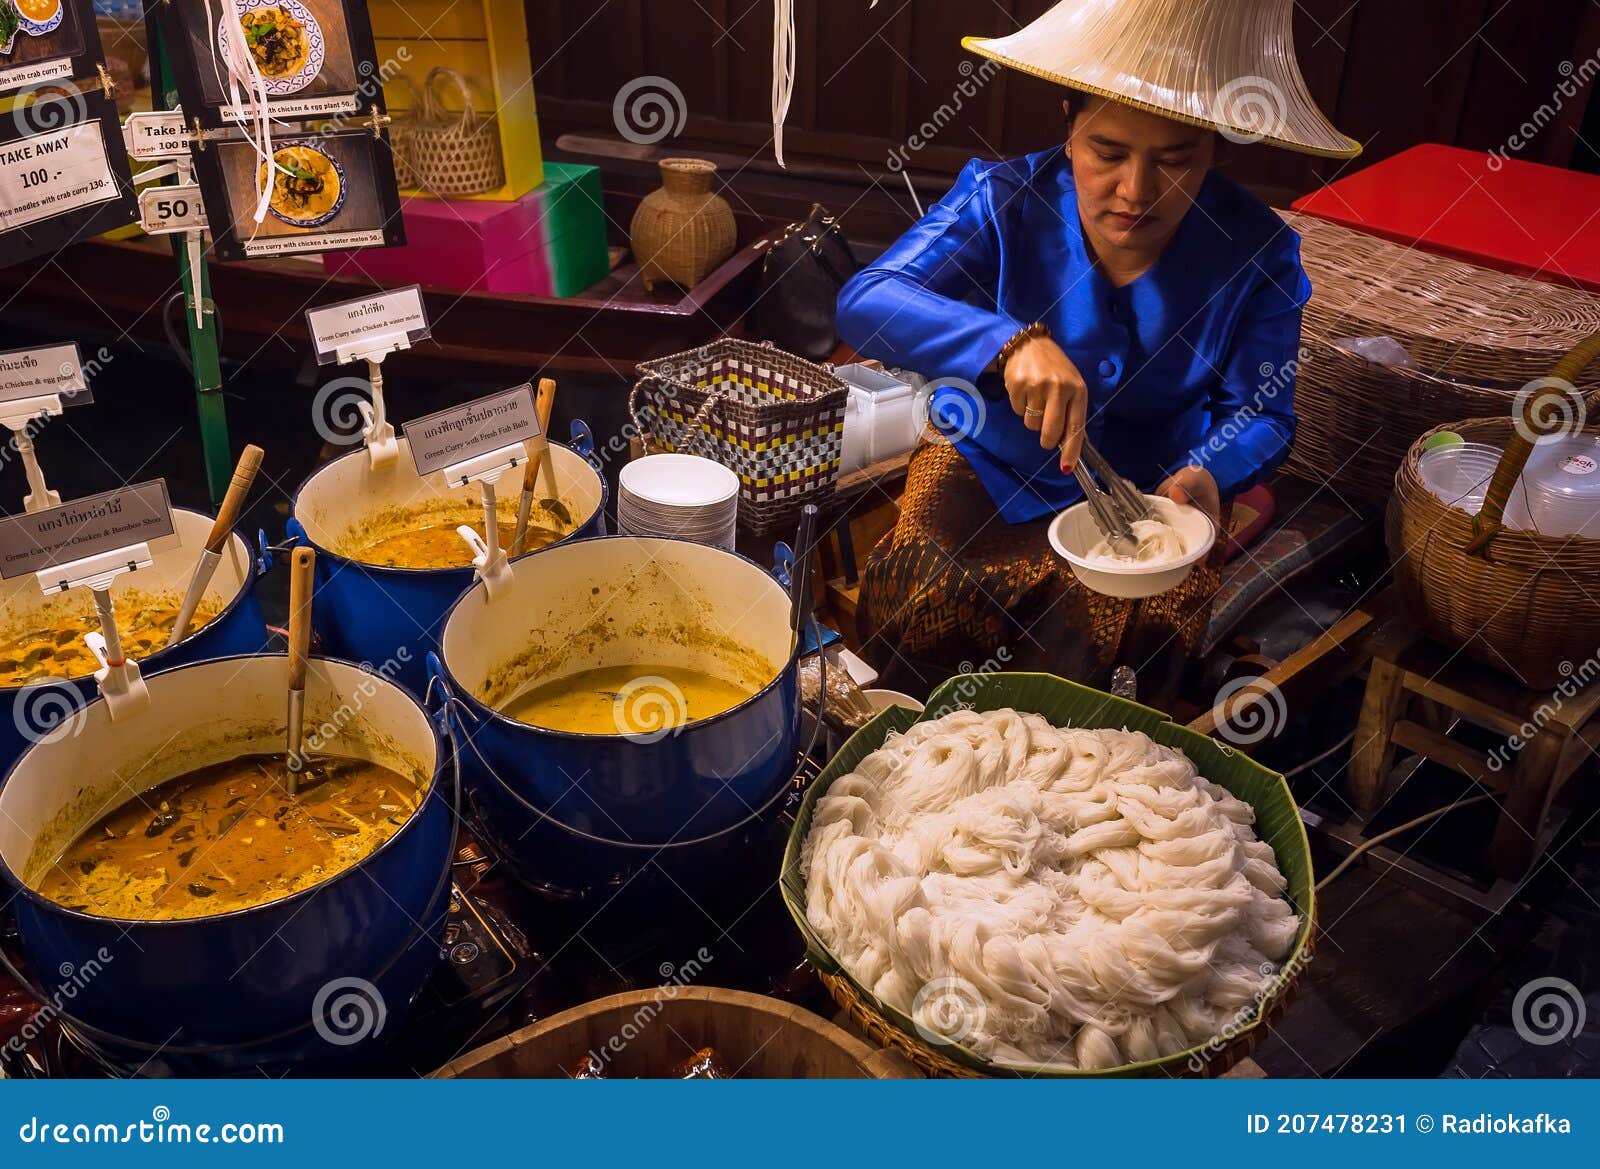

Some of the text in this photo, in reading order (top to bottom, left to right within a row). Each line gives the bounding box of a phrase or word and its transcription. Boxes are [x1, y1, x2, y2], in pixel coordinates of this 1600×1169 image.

[12, 72, 26, 81] with
[27, 70, 41, 79] crab
[42, 67, 58, 77] curry
[277, 104, 302, 113] chicken
[324, 102, 340, 110] plant
[145, 125, 176, 136] Take
[0, 137, 70, 165] TAKE AWAY
[159, 141, 179, 150] 100
[20, 168, 48, 188] 100
[14, 201, 40, 214] noodles
[41, 195, 56, 205] with
[56, 189, 71, 200] crab
[72, 184, 89, 196] curry
[157, 200, 188, 219] 50
[246, 244, 264, 252] Green
[266, 243, 281, 251] curry
[298, 239, 321, 247] chicken
[318, 334, 335, 343] Green
[335, 331, 350, 340] Curry
[351, 328, 361, 336] with
[362, 323, 382, 332] Chicken
[389, 317, 404, 326] winter
[5, 379, 34, 389] Chicken
[34, 377, 41, 385] &
[43, 377, 55, 385] egg
[424, 419, 529, 461] Green Curry with Fresh Fish Balls
[5, 552, 29, 562] Green
[30, 545, 52, 557] Curry
[54, 540, 70, 550] with
[72, 531, 102, 546] Chicken
[103, 529, 111, 537] &
[112, 522, 141, 535] Bamboo
